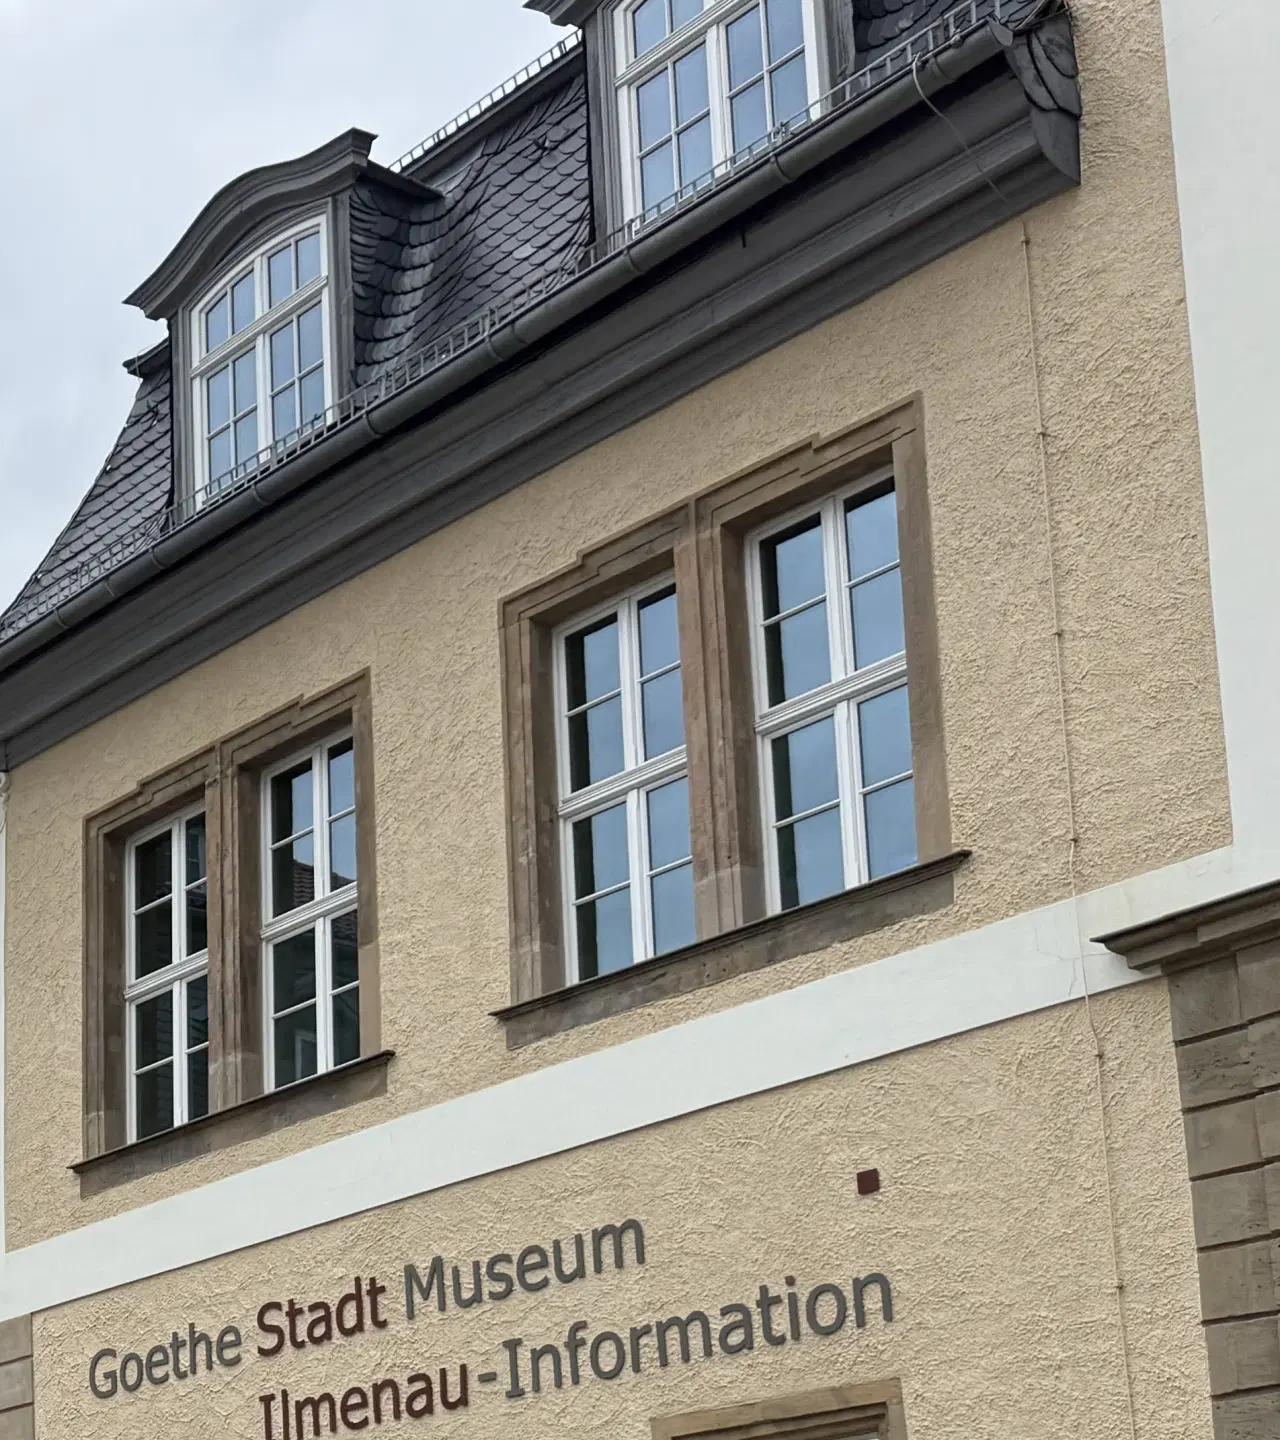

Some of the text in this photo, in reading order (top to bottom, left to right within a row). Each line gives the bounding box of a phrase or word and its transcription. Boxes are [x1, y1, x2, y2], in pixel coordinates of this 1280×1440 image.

[89, 1218, 646, 1400] Goethe Stadt Museum
